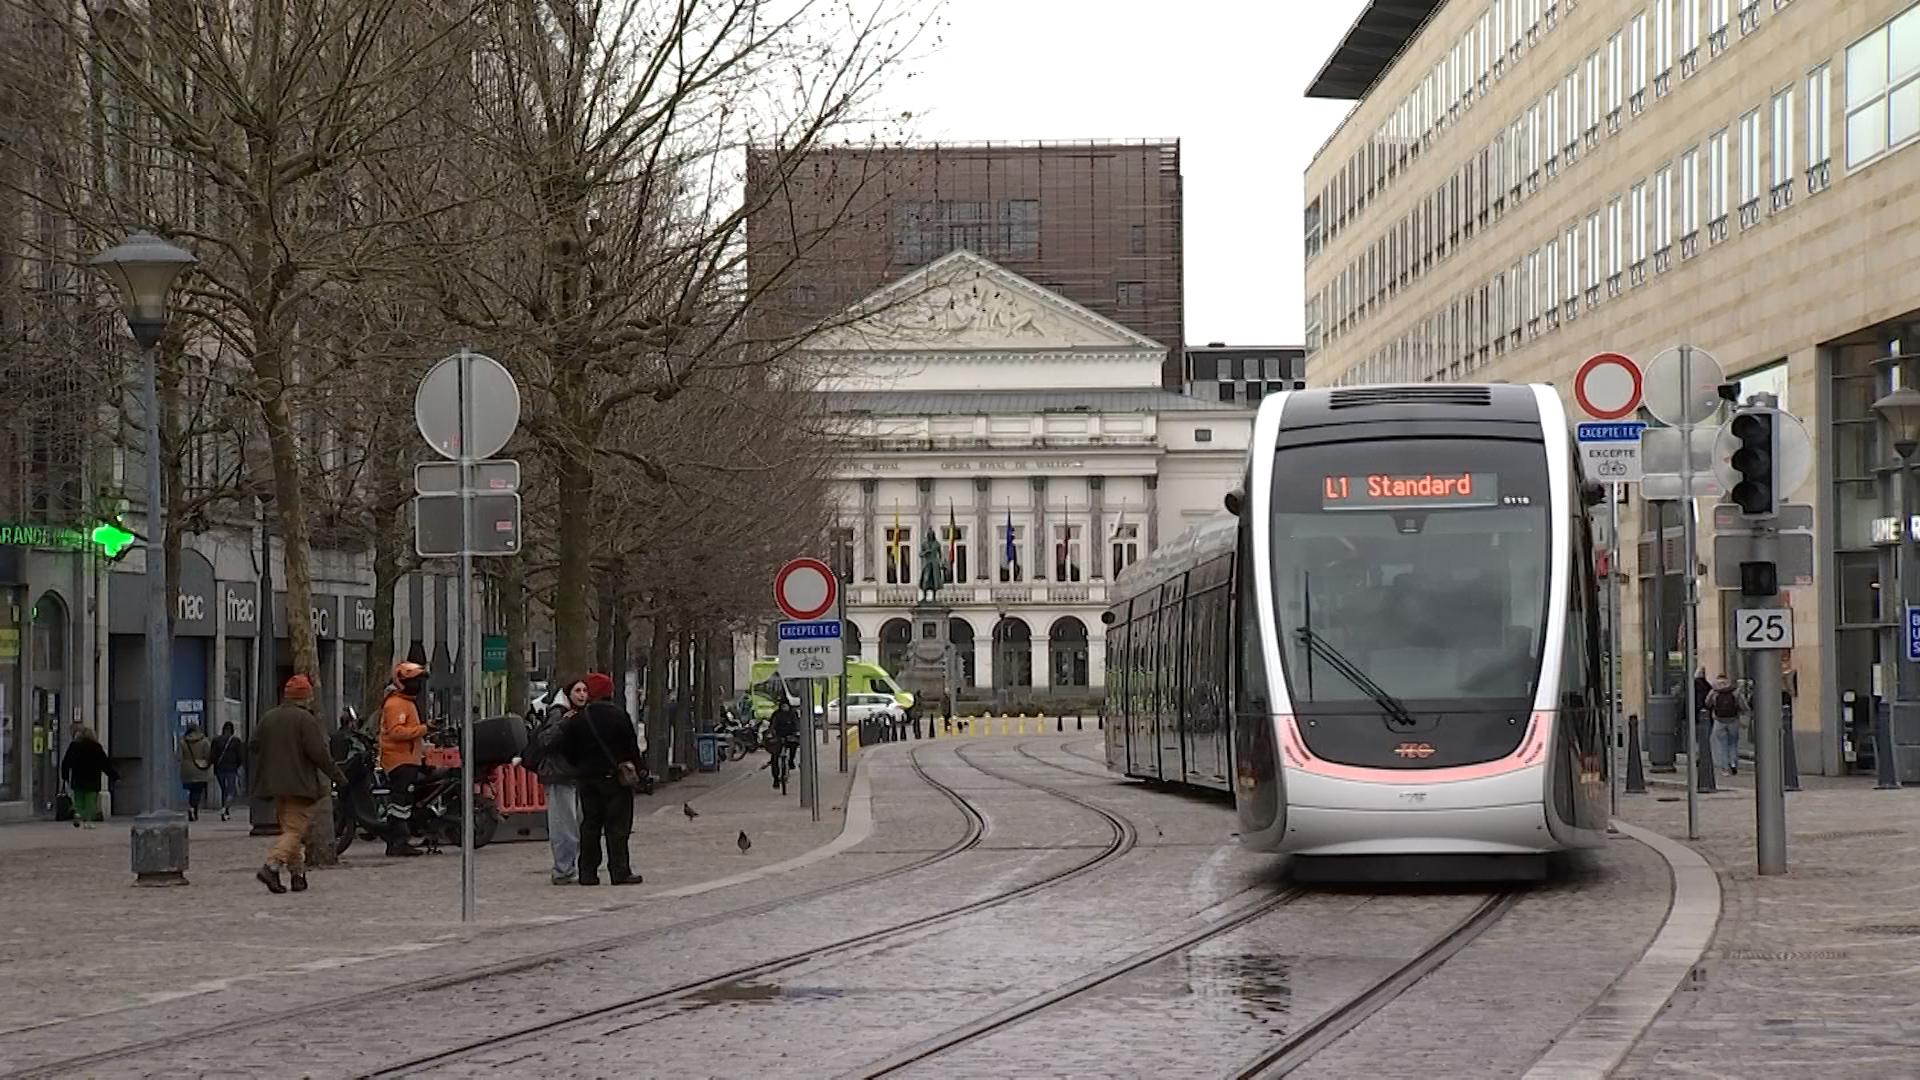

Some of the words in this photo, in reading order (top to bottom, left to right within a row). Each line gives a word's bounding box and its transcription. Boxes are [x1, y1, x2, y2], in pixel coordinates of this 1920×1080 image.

[1325, 477, 1349, 499] L1
[1367, 474, 1472, 497] Standard
[178, 586, 204, 620] nac
[226, 588, 255, 622] fnac
[355, 600, 375, 630] fna
[1745, 614, 1785, 642] 25
